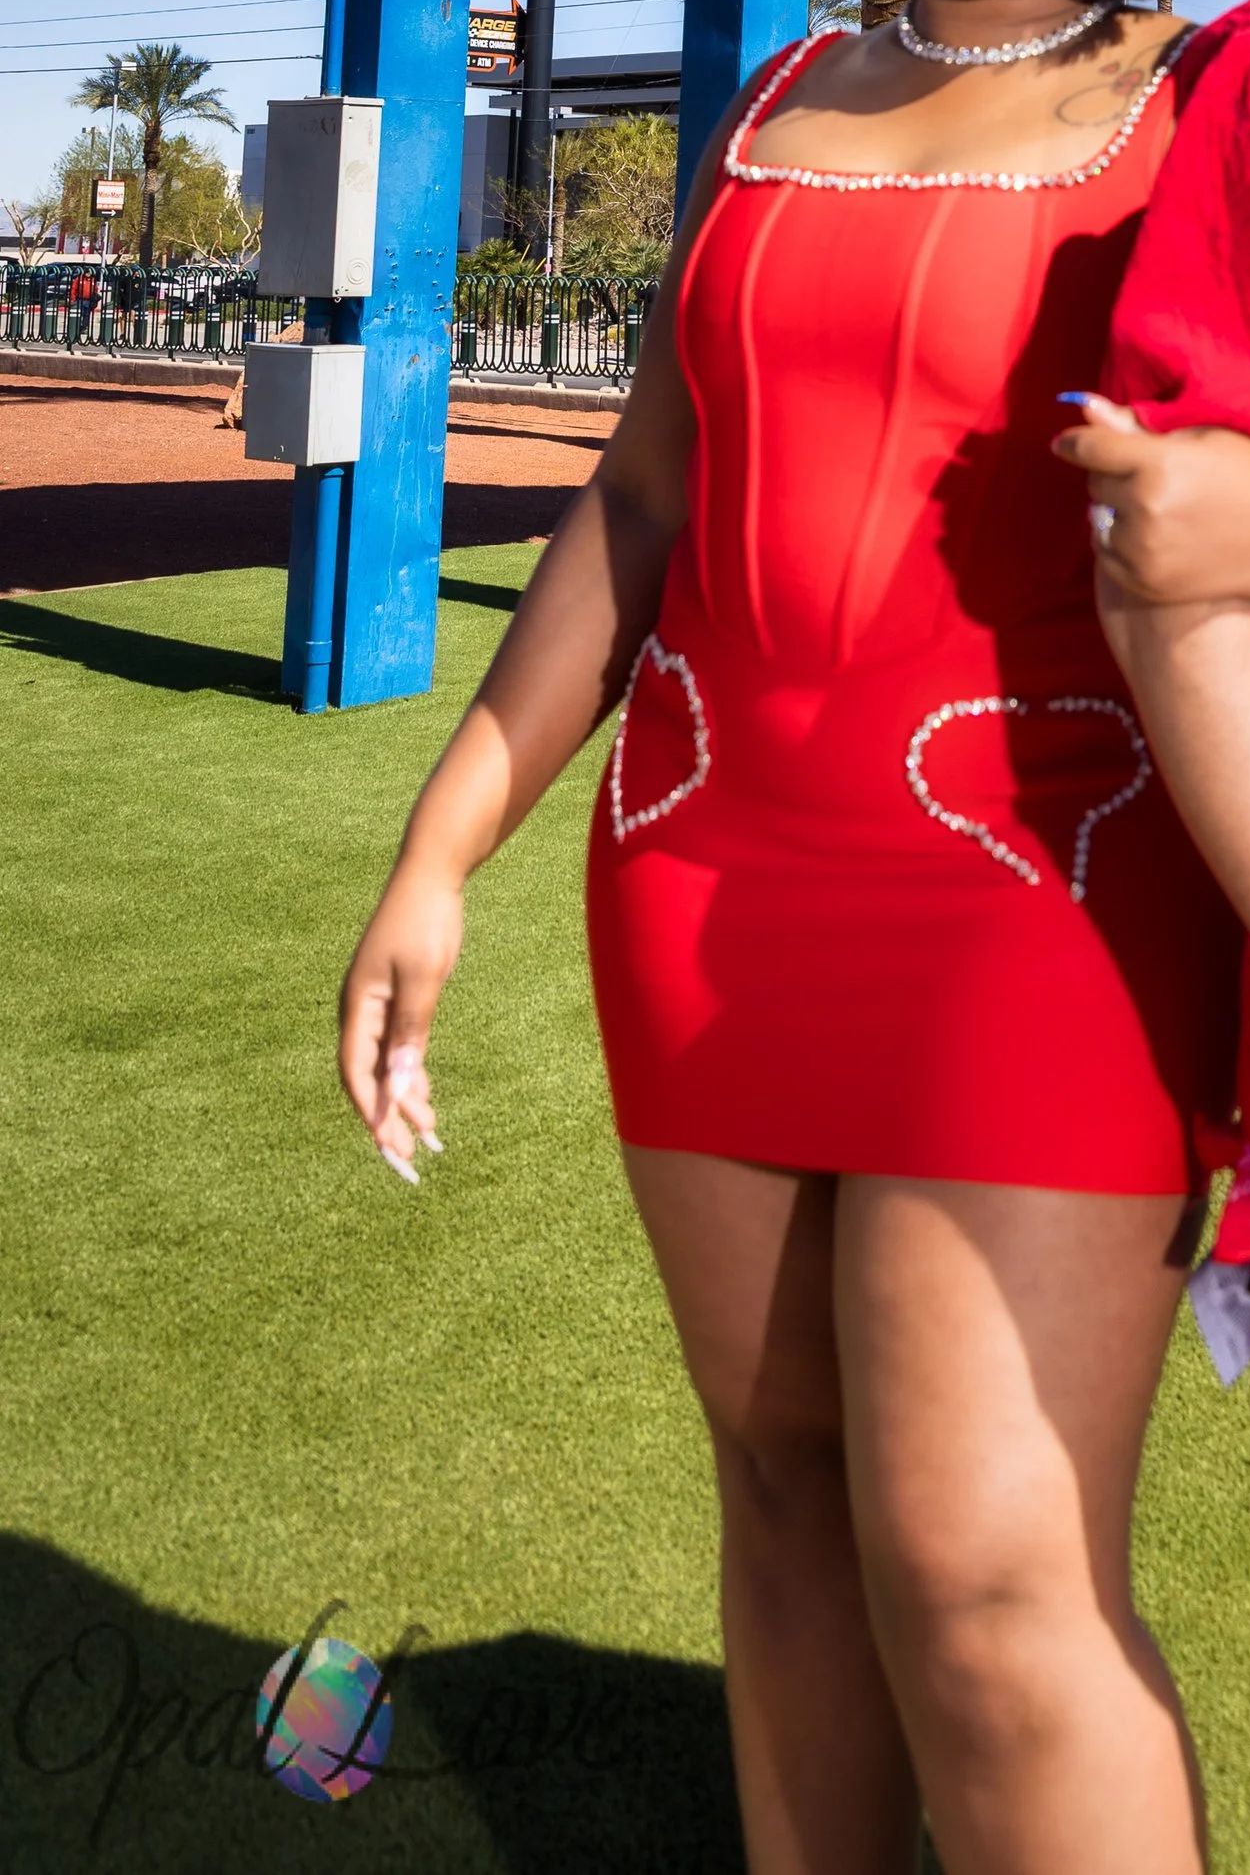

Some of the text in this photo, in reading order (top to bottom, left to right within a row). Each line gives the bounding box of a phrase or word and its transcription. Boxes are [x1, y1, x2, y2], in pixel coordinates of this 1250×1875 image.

[470, 38, 516, 51] DEVICE CHARGING
[477, 57, 491, 67] ATM
